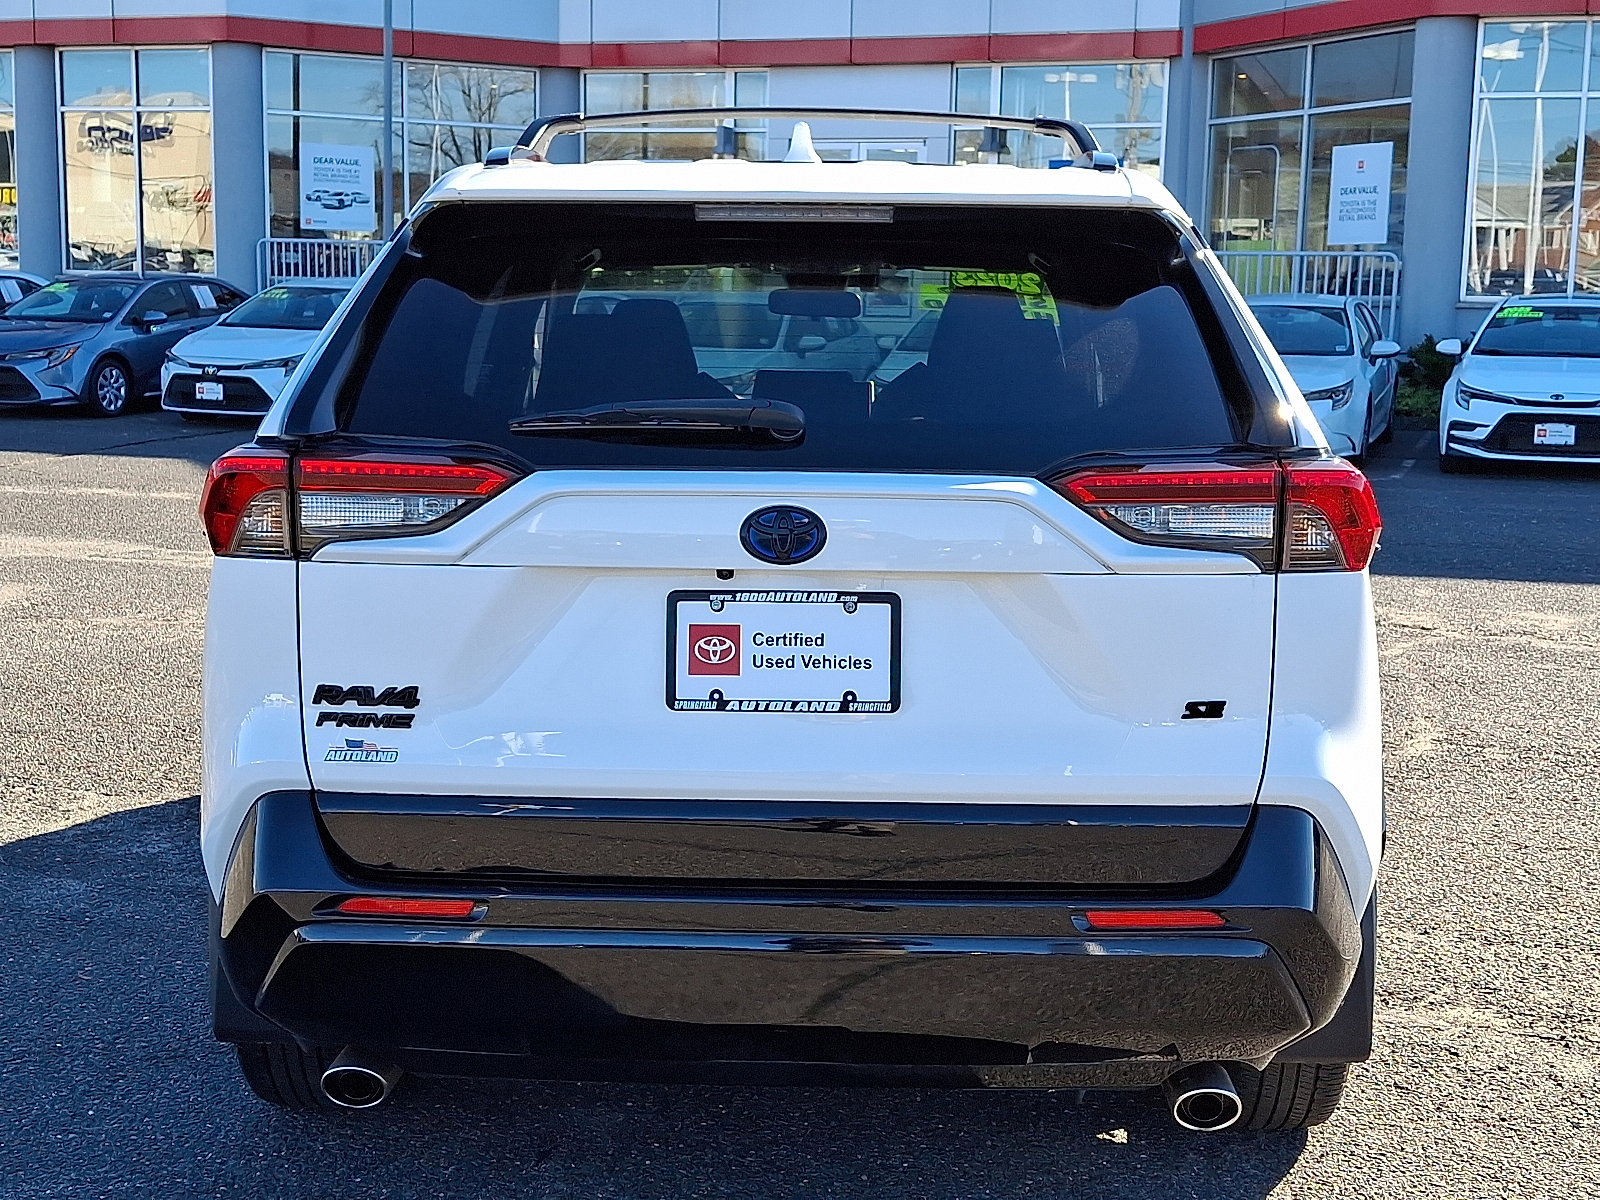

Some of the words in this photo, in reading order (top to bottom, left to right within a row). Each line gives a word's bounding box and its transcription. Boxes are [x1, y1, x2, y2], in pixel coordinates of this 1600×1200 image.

[313, 156, 334, 165] DEAR
[334, 157, 361, 167] VALUE,
[1340, 186, 1357, 196] DEAR
[752, 632, 825, 647] Certified
[752, 653, 796, 669] Used
[800, 654, 873, 670] Vehicles
[312, 684, 420, 709] RAV4
[673, 700, 718, 710] SPRINGFIELD
[725, 700, 842, 712] AUTOLAND
[848, 702, 892, 712] SPRINGFIELD
[315, 712, 416, 729] PRIME
[325, 750, 398, 762] AUTOLAND
